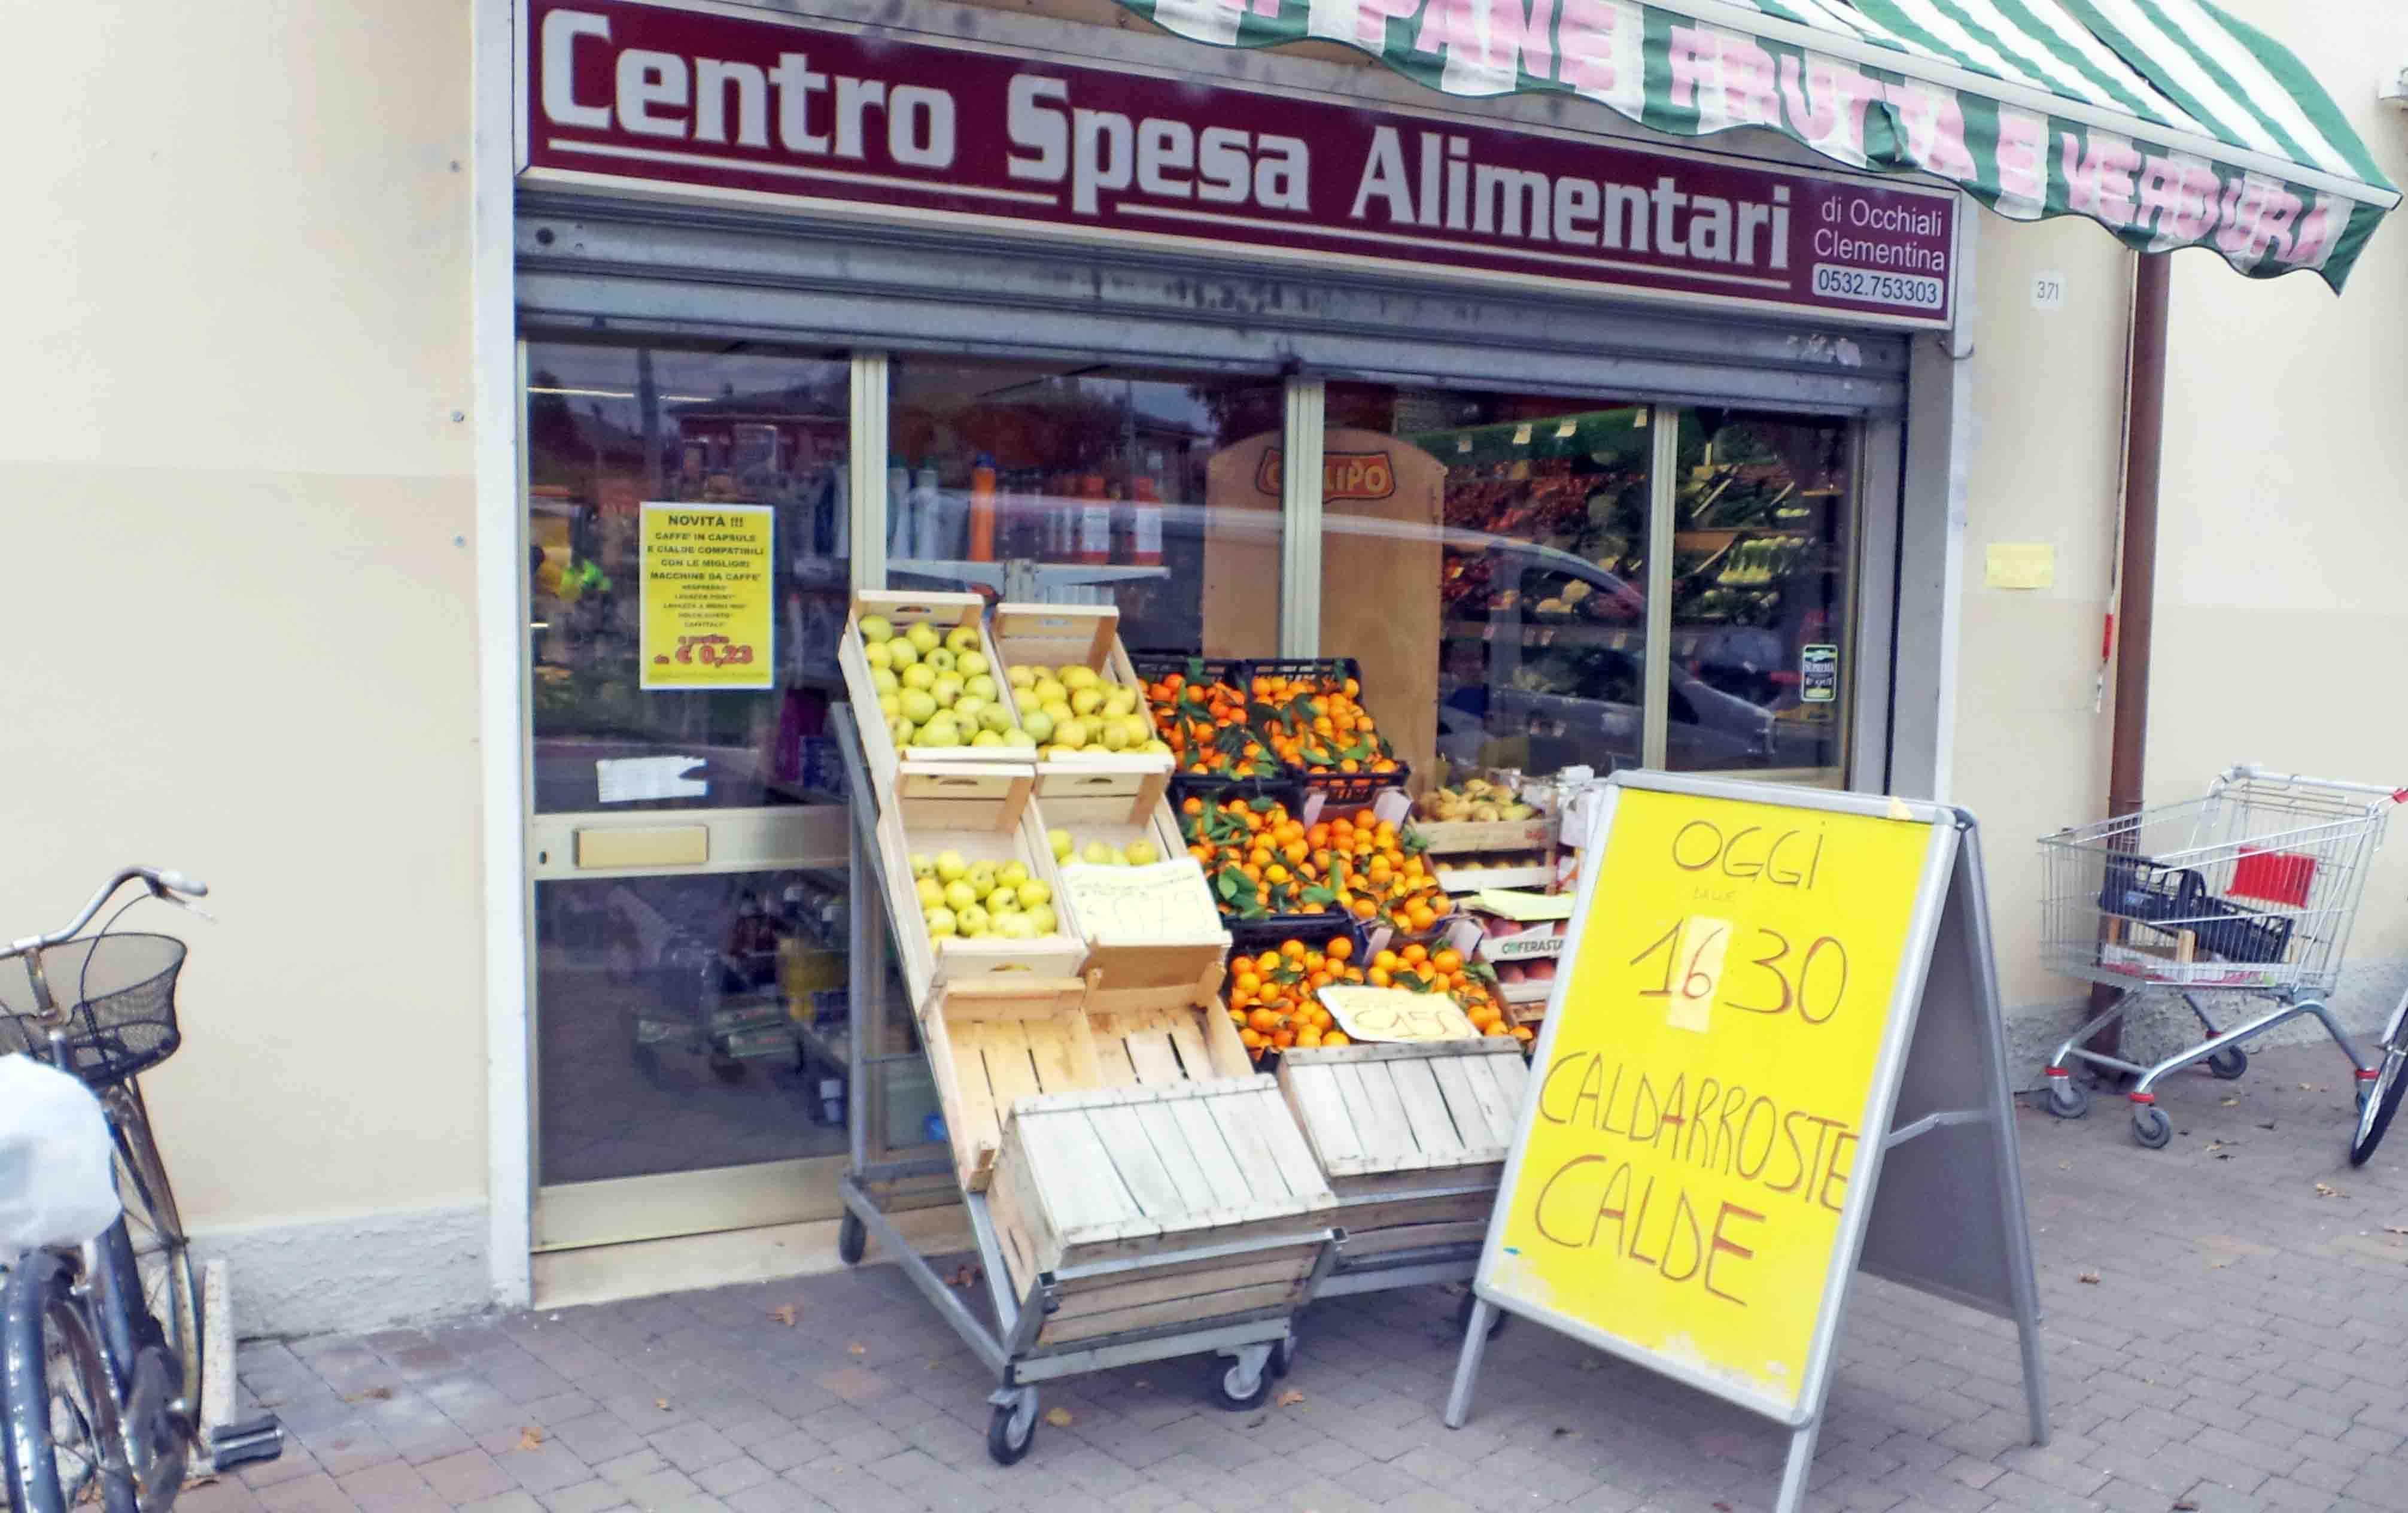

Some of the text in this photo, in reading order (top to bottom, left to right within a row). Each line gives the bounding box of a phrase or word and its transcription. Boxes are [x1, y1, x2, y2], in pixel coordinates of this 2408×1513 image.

[541, 8, 1790, 270] Centro Spesa Alimentari
[1822, 196, 1942, 238] di Occhiali
[2061, 130, 2328, 265] VERDURA
[1813, 227, 1945, 272] Clementina
[1818, 268, 1938, 304] 0532.753303
[2036, 279, 2059, 300] 371
[1265, 458, 1388, 493] CLIPO
[694, 533, 705, 542] IN
[1539, 1051, 1860, 1215] CALDARROSTE
[1535, 1153, 1767, 1307] CALDE
